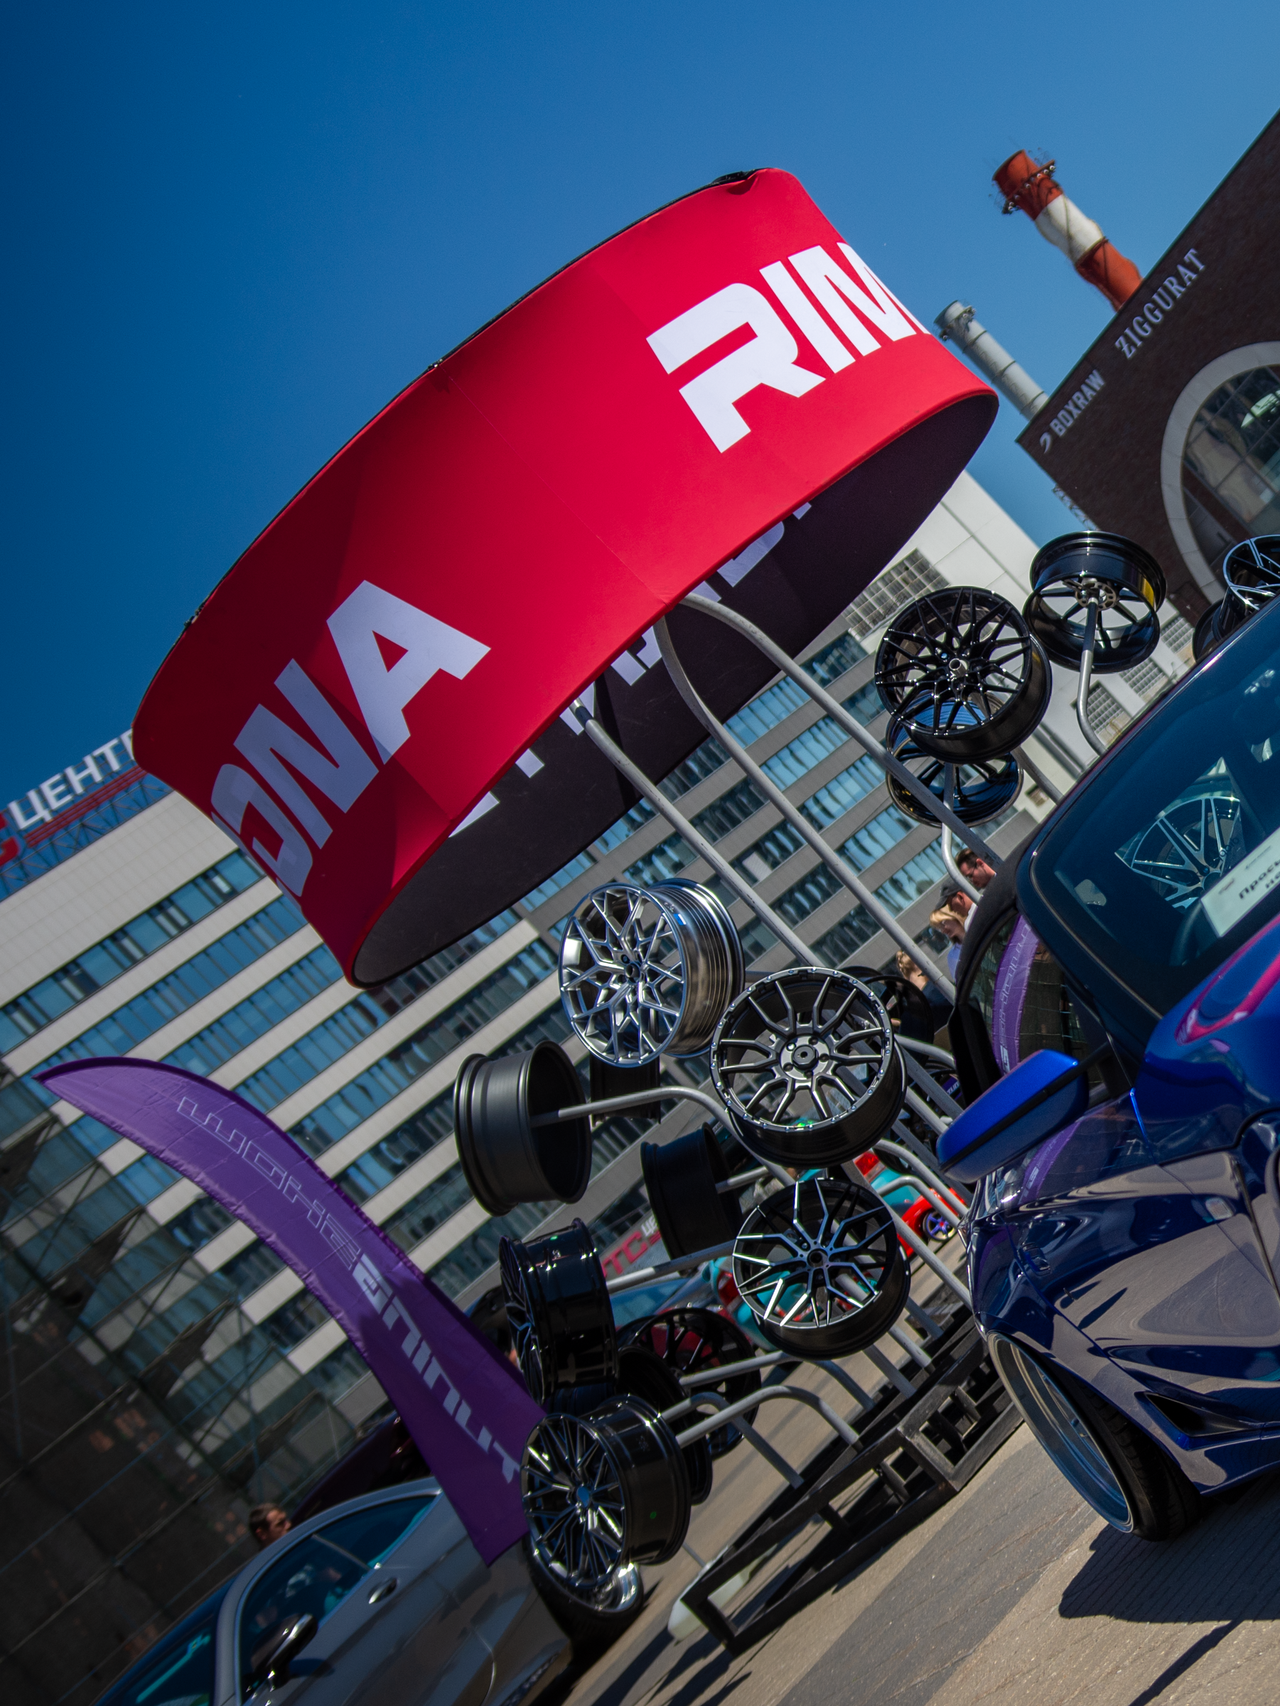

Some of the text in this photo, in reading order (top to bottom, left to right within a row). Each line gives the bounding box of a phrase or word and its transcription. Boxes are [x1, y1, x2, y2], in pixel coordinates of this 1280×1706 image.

[1114, 247, 1206, 360] ZIGGURAT
[1049, 369, 1107, 438] BOXRAW
[211, 579, 491, 905] ONA
